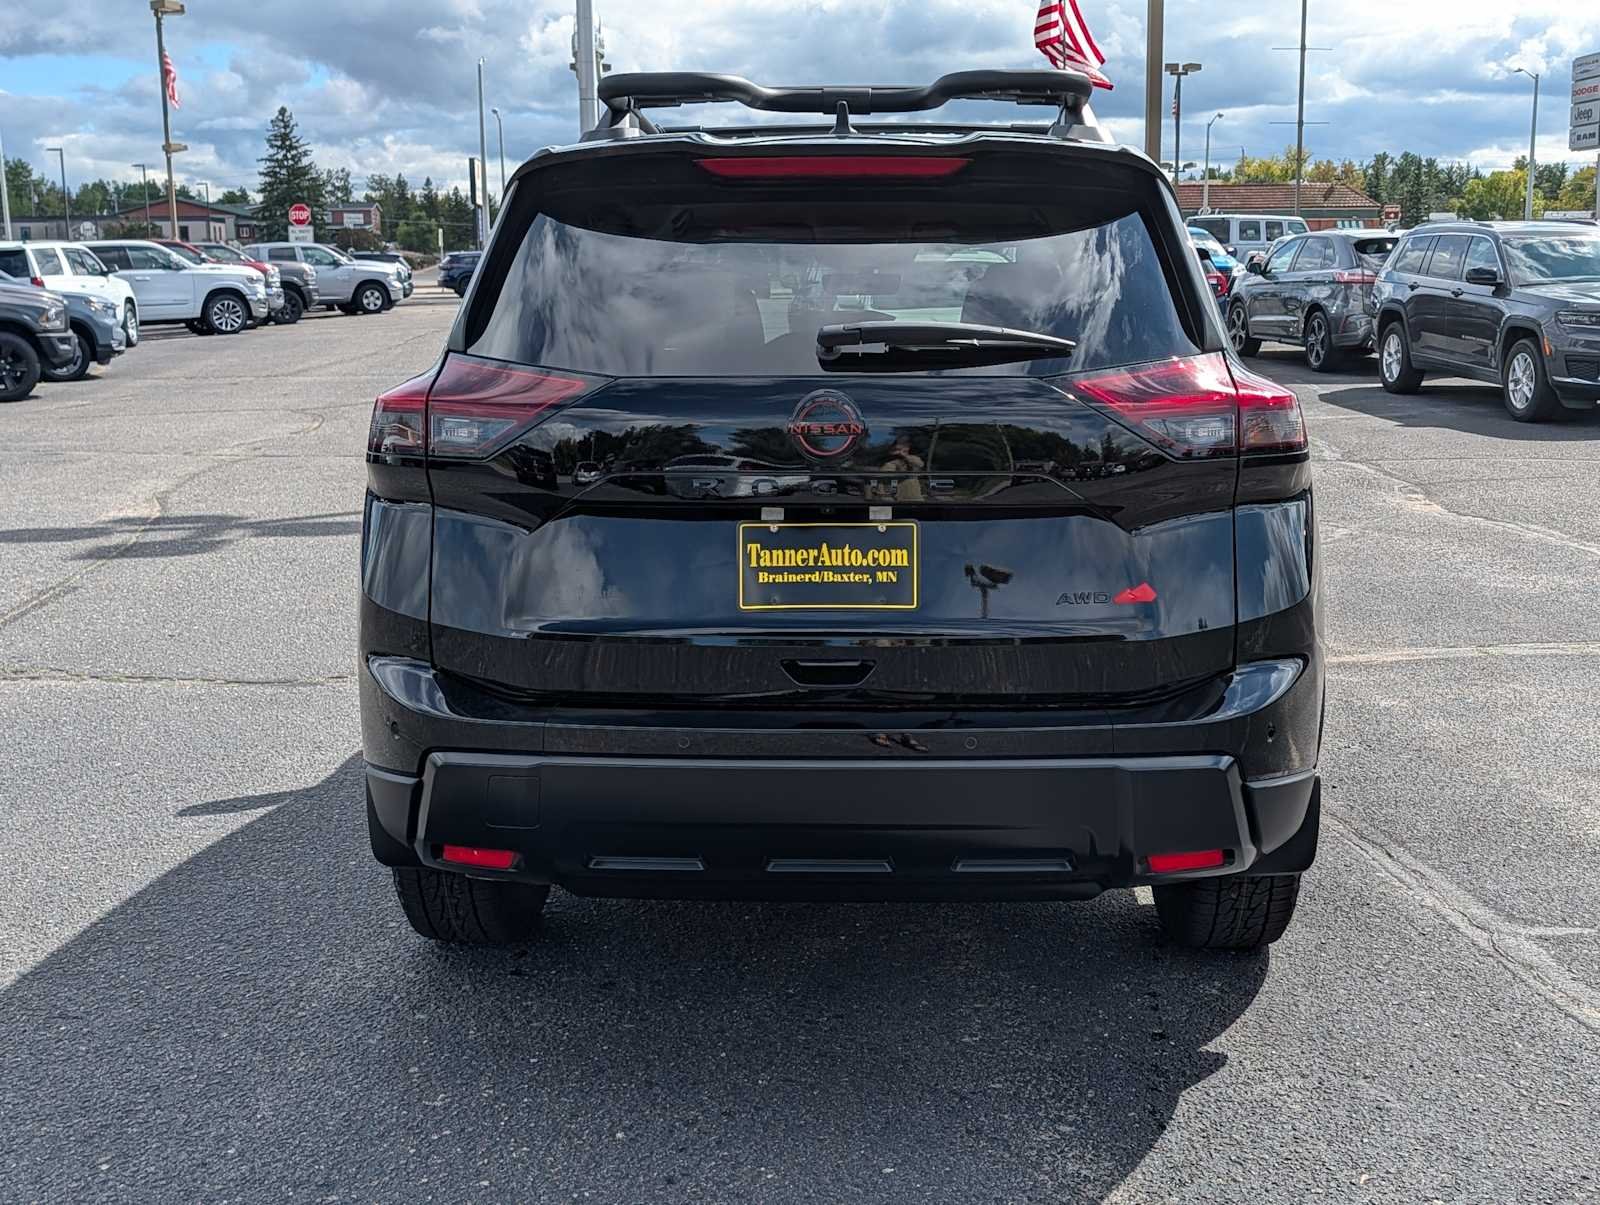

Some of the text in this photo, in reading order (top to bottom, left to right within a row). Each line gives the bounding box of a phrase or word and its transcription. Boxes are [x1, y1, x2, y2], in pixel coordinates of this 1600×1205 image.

[1573, 85, 1599, 97] DODGE
[1574, 107, 1593, 121] Jeep
[1577, 132, 1596, 141] RAM
[291, 211, 310, 220] STOP
[789, 424, 862, 434] NISSAN
[692, 478, 956, 498] ROGUE
[747, 542, 909, 568] TannerAuto.com
[758, 570, 898, 585] Brainerd/Baxter, MN
[1056, 591, 1111, 606] AWD
